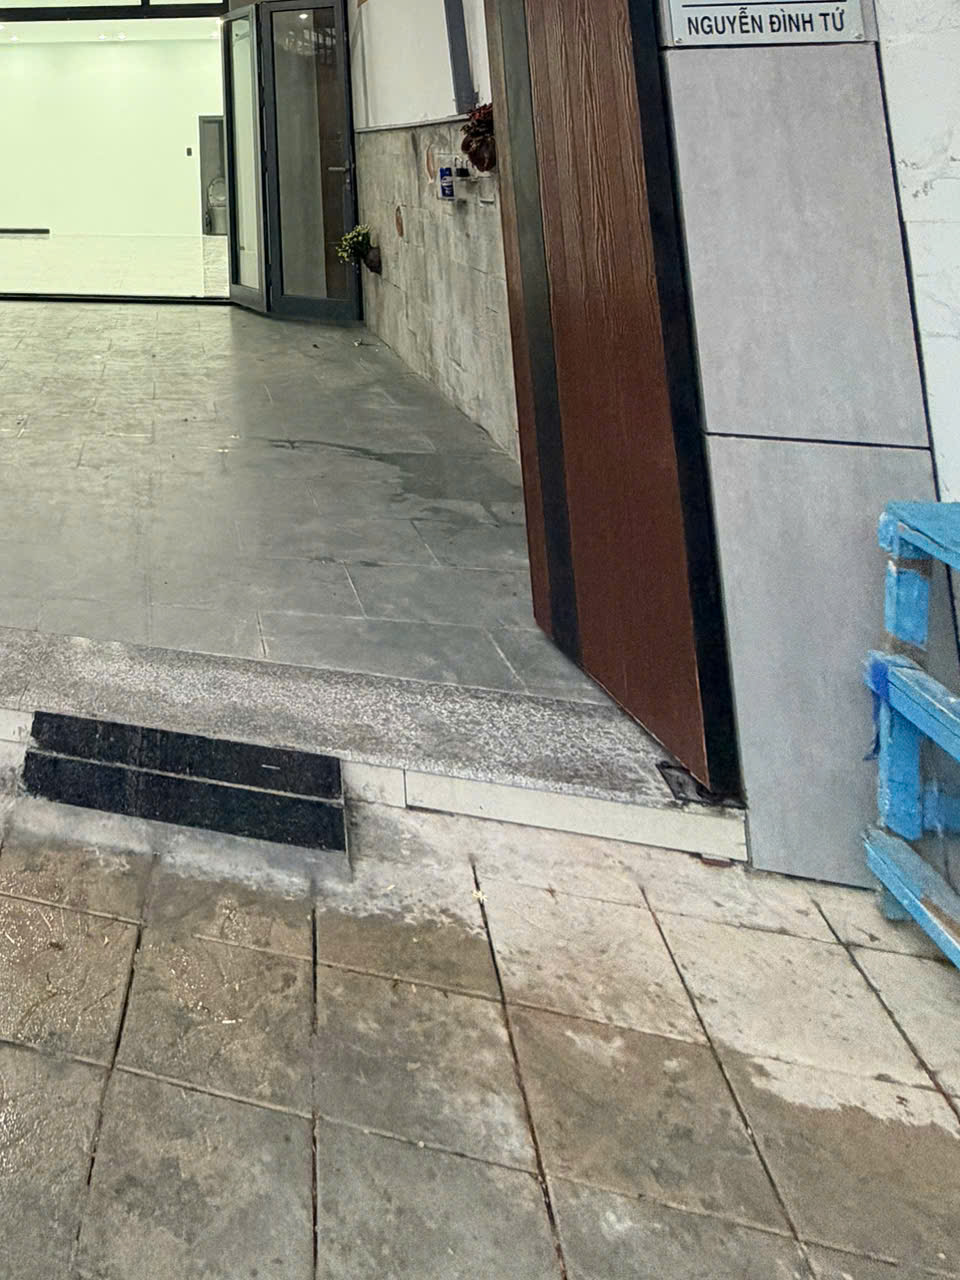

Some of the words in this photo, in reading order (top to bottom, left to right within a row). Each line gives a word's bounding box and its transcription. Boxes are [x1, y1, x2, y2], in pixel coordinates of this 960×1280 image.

[687, 7, 764, 35] NGUYỄN
[769, 8, 814, 33] ĐÌNH
[819, 6, 845, 32] TỨ
